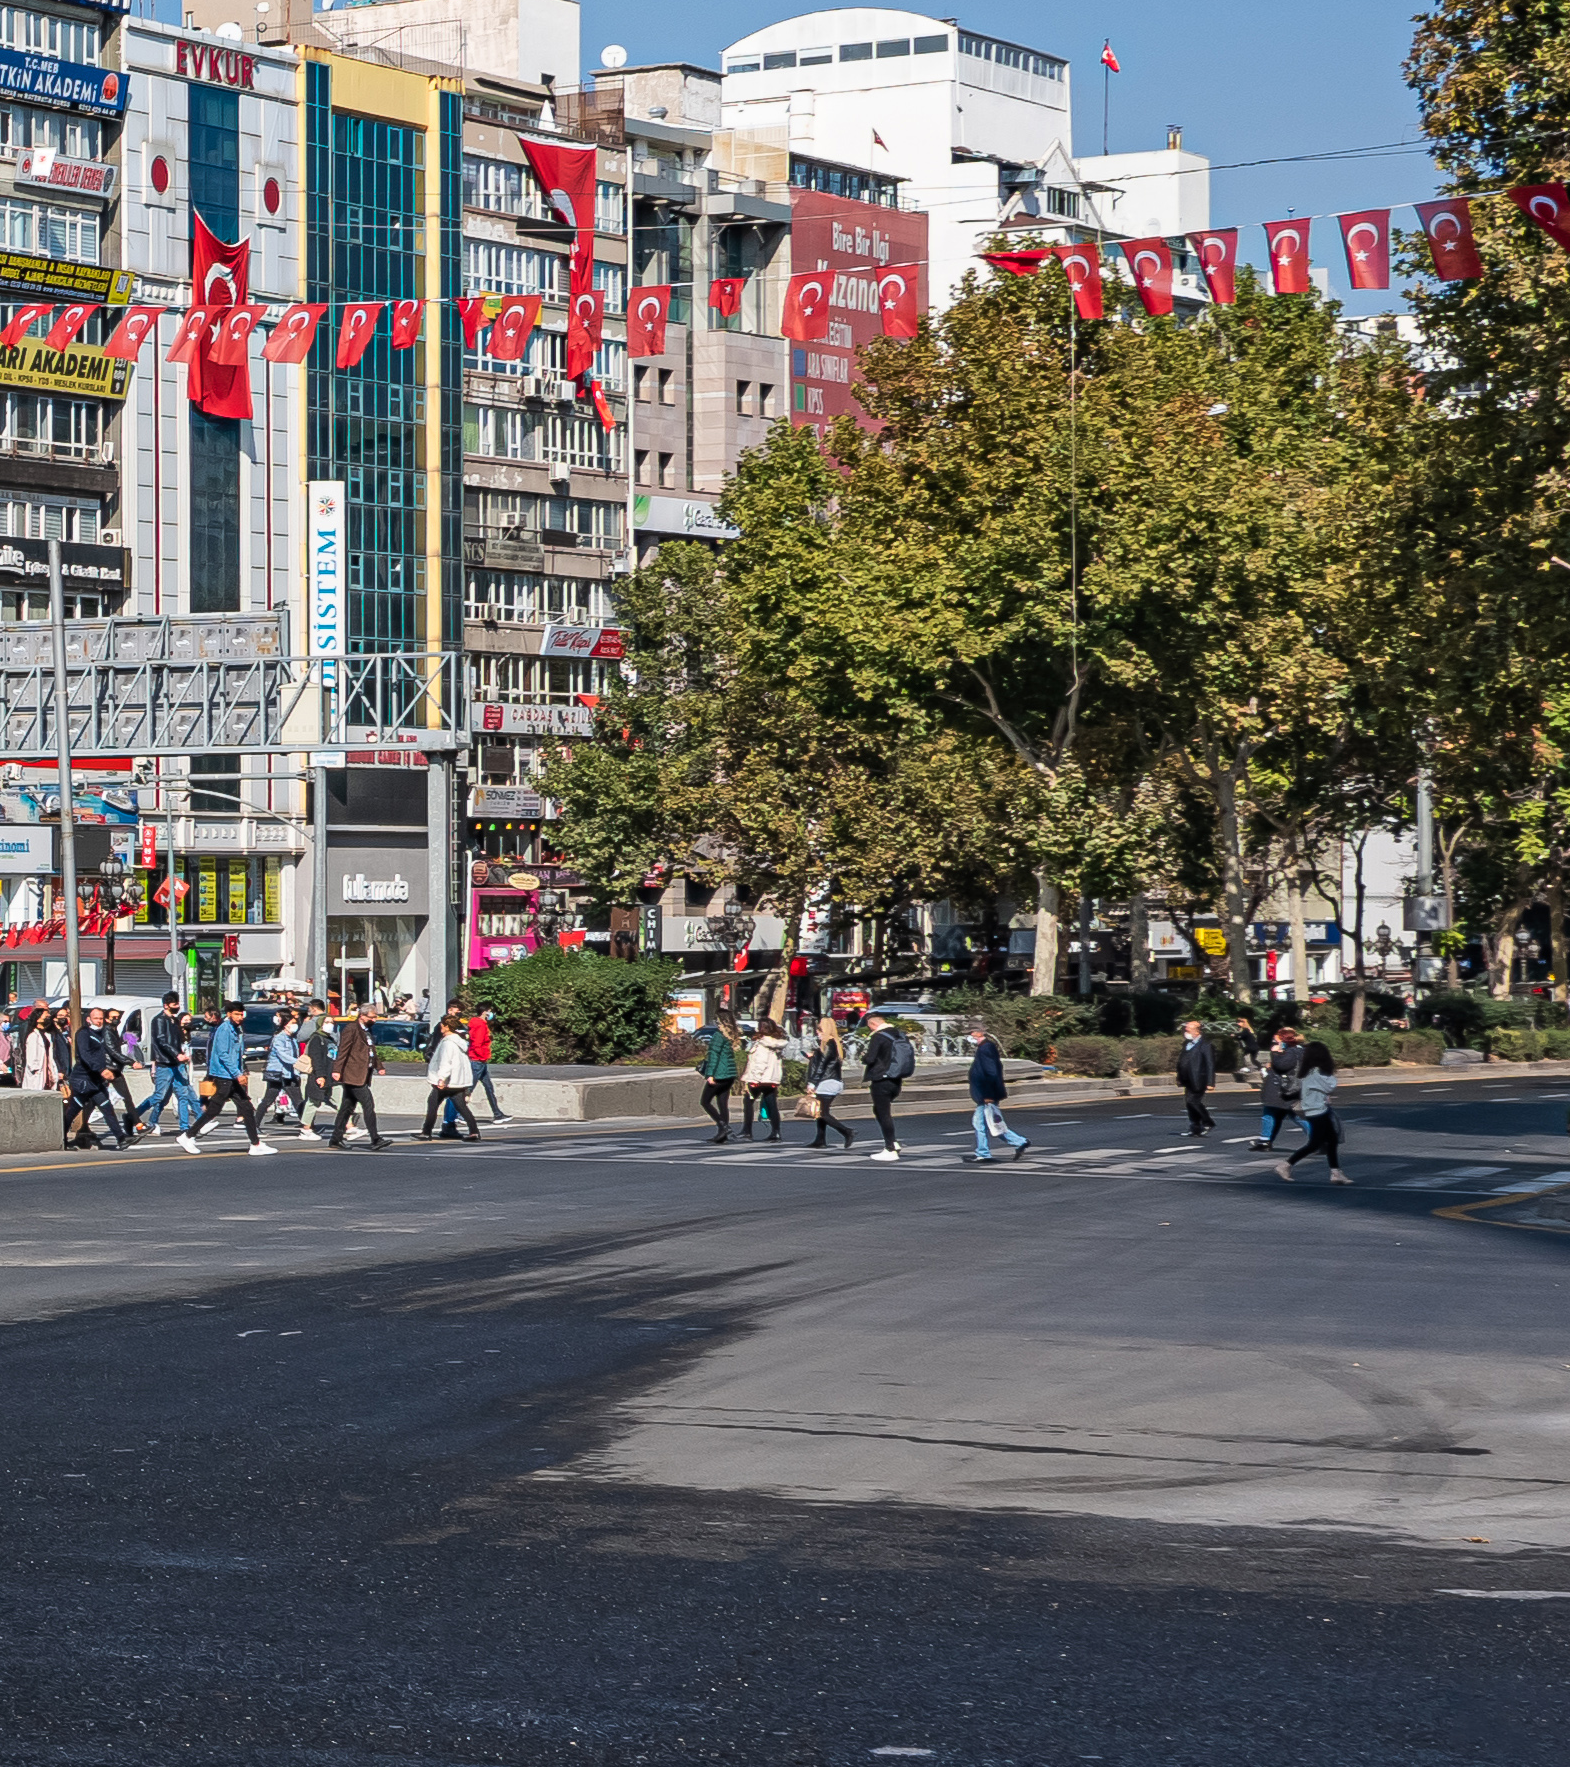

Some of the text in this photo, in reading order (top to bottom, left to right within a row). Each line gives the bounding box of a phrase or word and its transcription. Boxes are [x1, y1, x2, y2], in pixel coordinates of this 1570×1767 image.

[177, 40, 255, 90] EVKUR
[832, 221, 853, 254] Bire
[855, 226, 871, 257] Bir
[314, 528, 337, 651] SİSTEM
